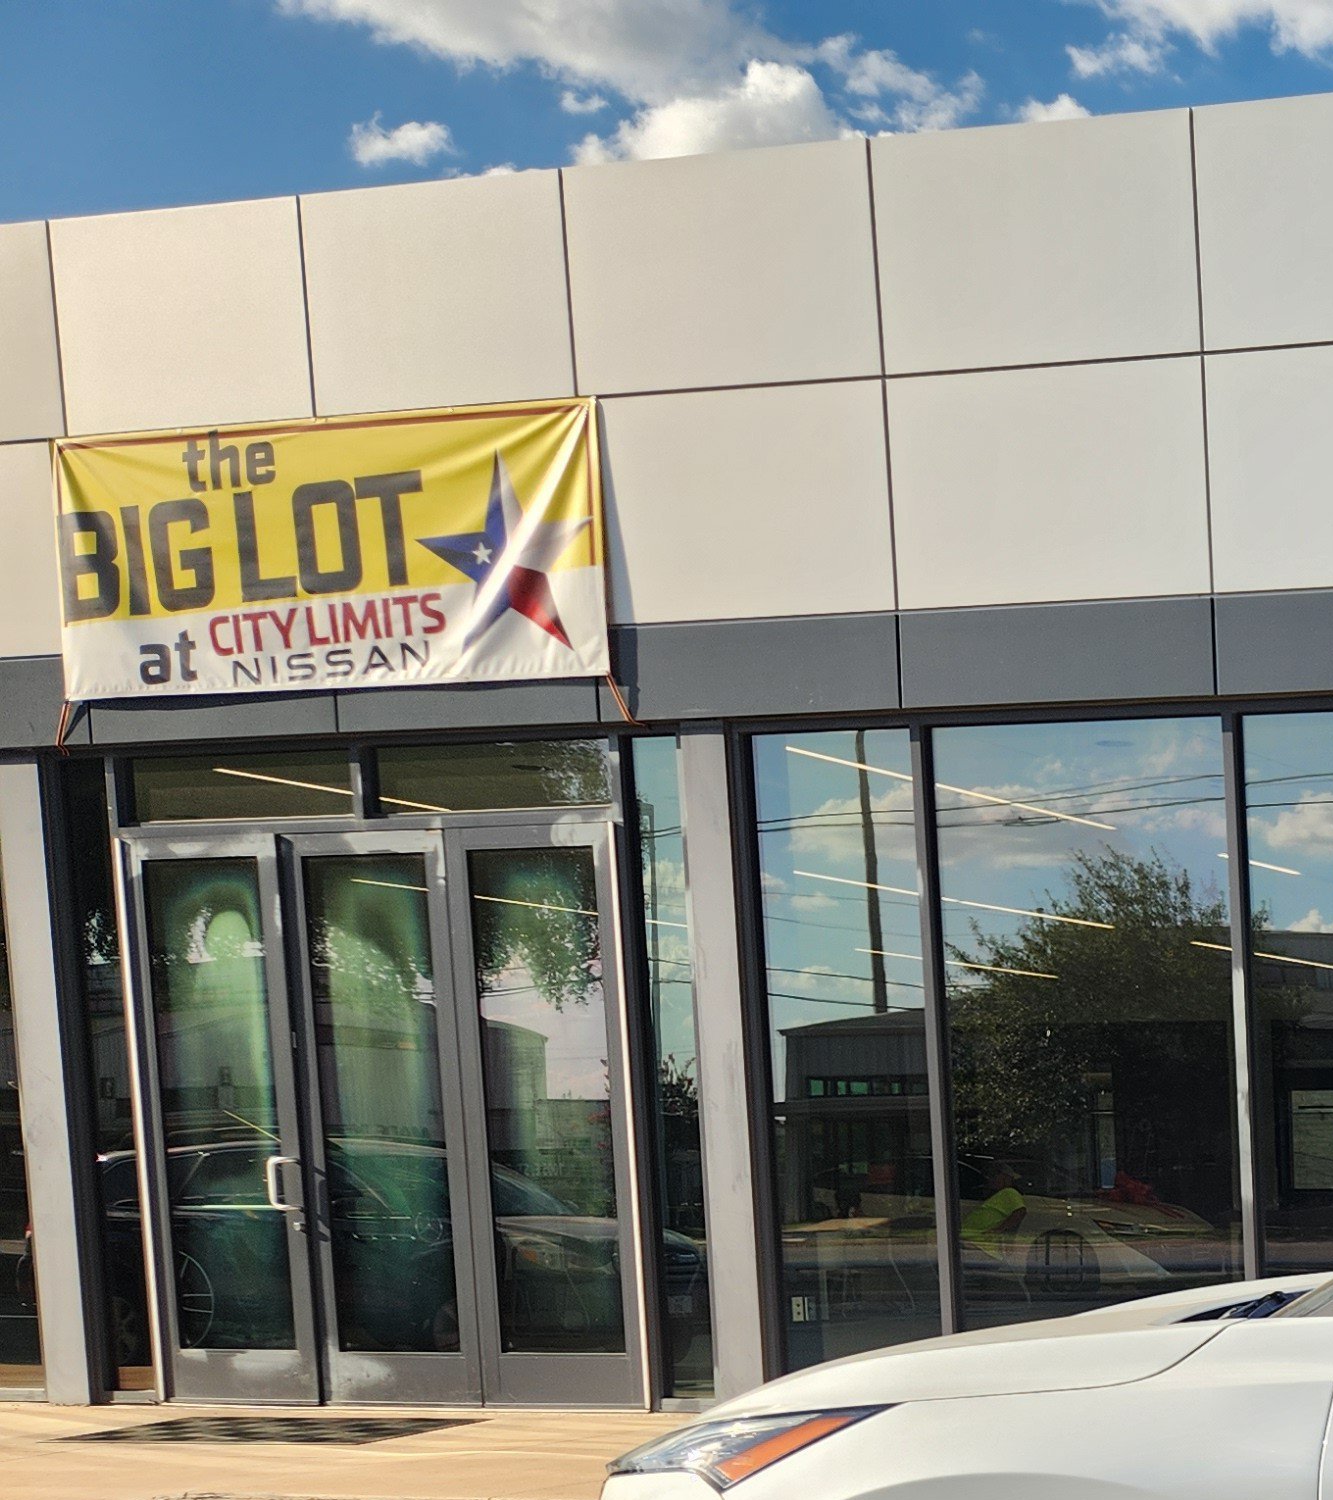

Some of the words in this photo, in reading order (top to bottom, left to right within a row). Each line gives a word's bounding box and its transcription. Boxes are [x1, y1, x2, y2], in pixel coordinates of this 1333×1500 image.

[183, 430, 276, 492] the
[57, 498, 216, 623] BIG
[234, 470, 424, 602] LOT
[210, 606, 301, 657] CITY
[306, 593, 447, 646] LIMITS
[140, 630, 198, 686] at
[232, 640, 431, 686] NISSAN
